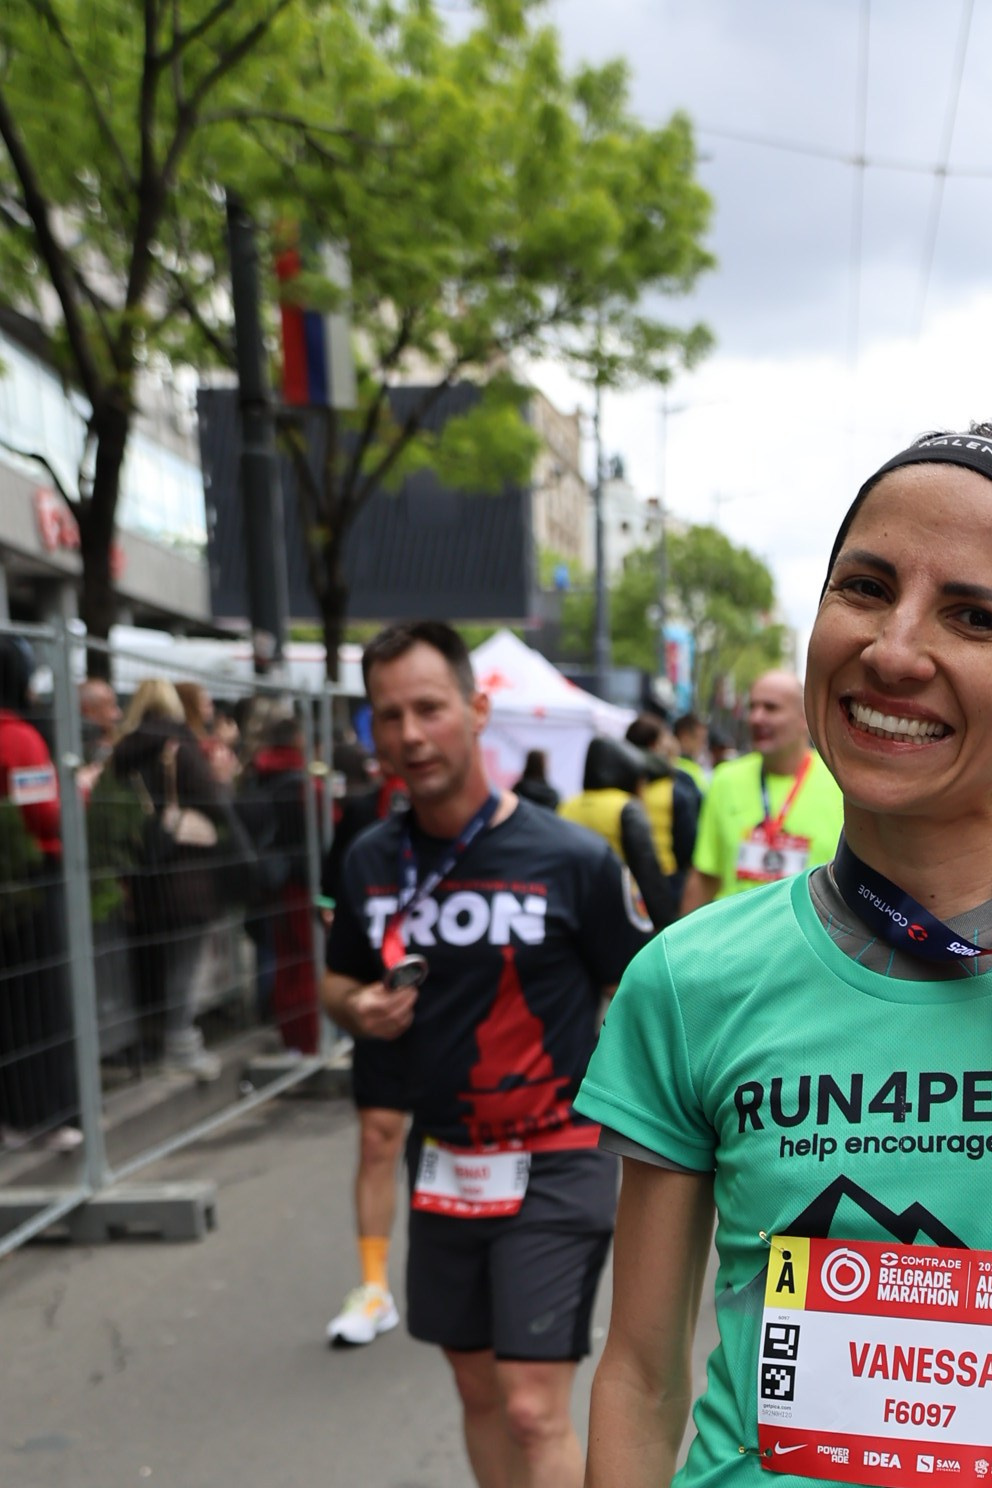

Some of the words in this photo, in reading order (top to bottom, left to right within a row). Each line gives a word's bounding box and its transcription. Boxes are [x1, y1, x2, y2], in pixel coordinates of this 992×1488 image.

[858, 884, 908, 927] COMTRADE
[780, 1133, 838, 1162] help
[901, 1255, 962, 1269] COMTRADE
[879, 1267, 952, 1290] BELGRADE
[877, 1284, 959, 1307] MARATHON
[884, 1398, 957, 1428] F6097
[817, 1445, 850, 1458] POWER
[936, 1459, 961, 1470] SAVA
